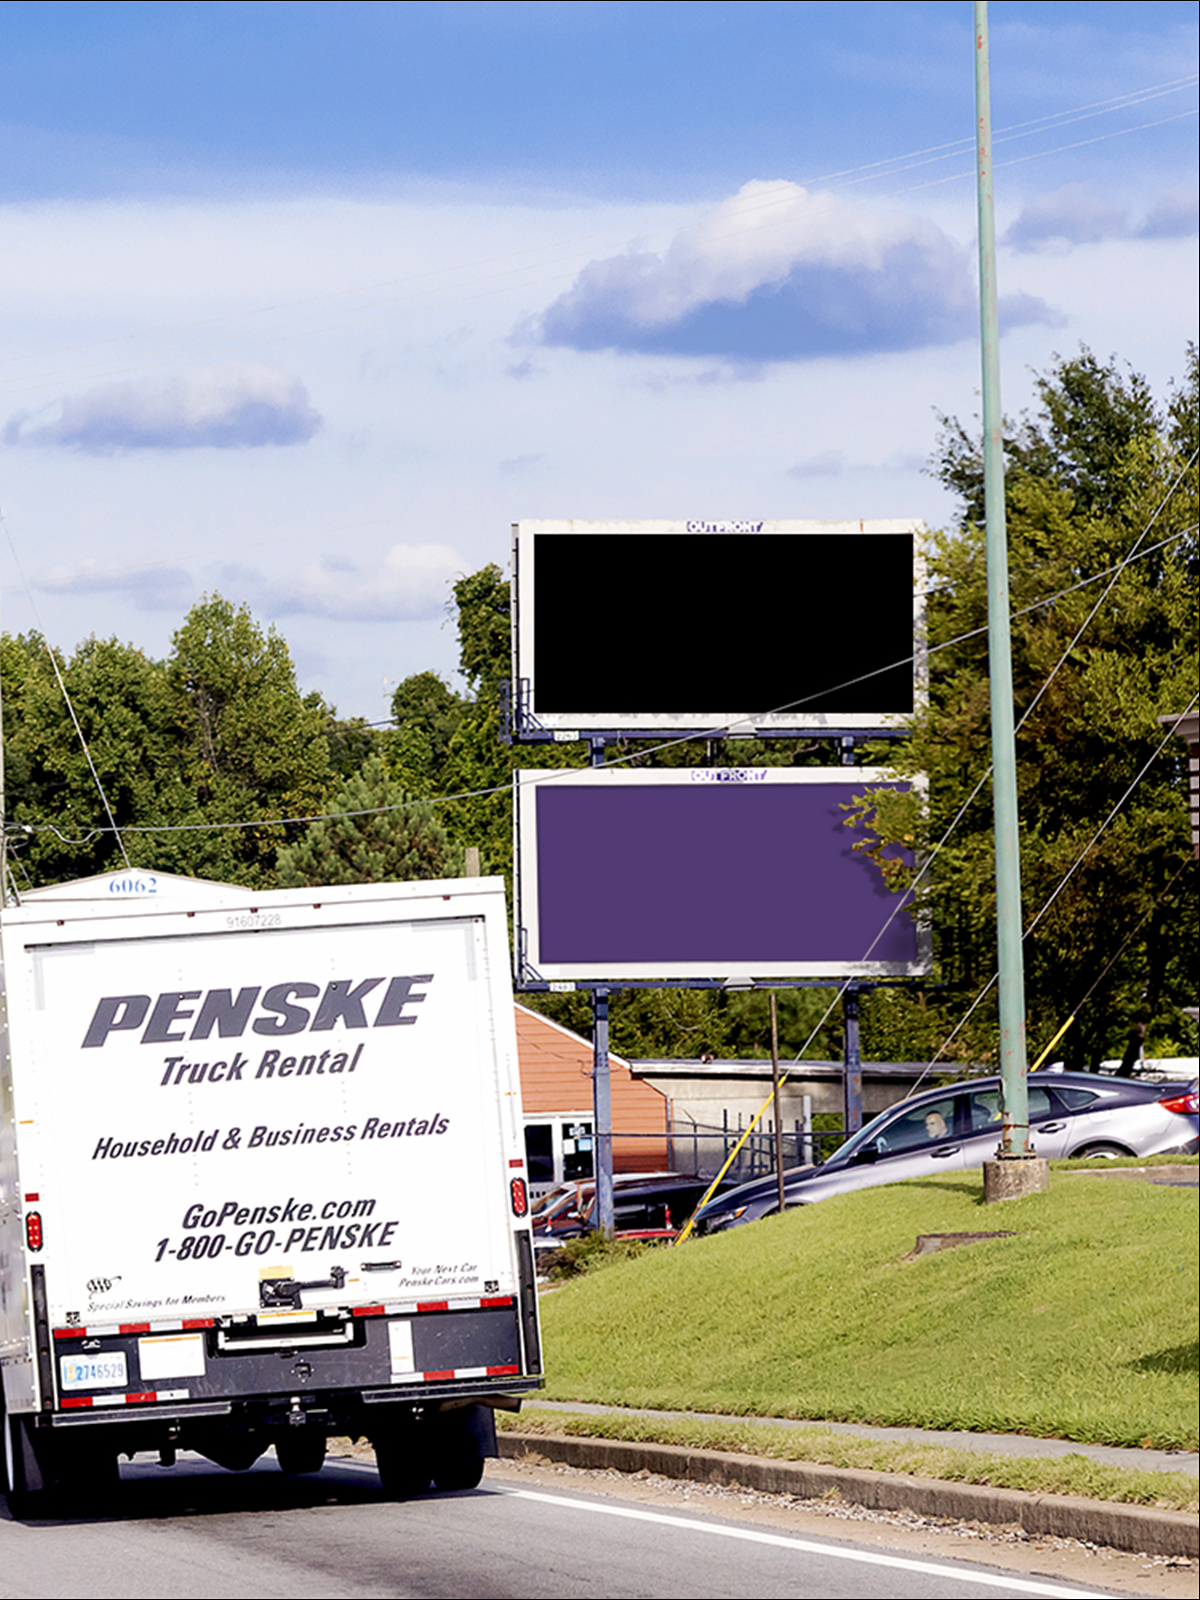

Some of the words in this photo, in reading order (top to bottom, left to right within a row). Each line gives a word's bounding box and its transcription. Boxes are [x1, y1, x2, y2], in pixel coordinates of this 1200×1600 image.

[109, 877, 157, 894] 6062
[226, 914, 282, 928] 91607228
[81, 974, 435, 1048] PENSKE
[160, 1052, 249, 1086] Truck
[254, 1043, 366, 1079] Rental
[92, 1129, 220, 1160] Household
[222, 1127, 242, 1150] &
[247, 1122, 358, 1149] Business
[360, 1113, 450, 1140] Rentals
[182, 1197, 377, 1230] GoPenske.com
[155, 1221, 400, 1263] 1-800-GO-PENSKE
[433, 1264, 458, 1274] Next
[460, 1263, 477, 1272] Car
[87, 1300, 124, 1313] Special
[125, 1298, 163, 1310] Savings
[165, 1296, 179, 1306] for
[181, 1294, 226, 1305] Members
[75, 1362, 124, 1382] 2746529
